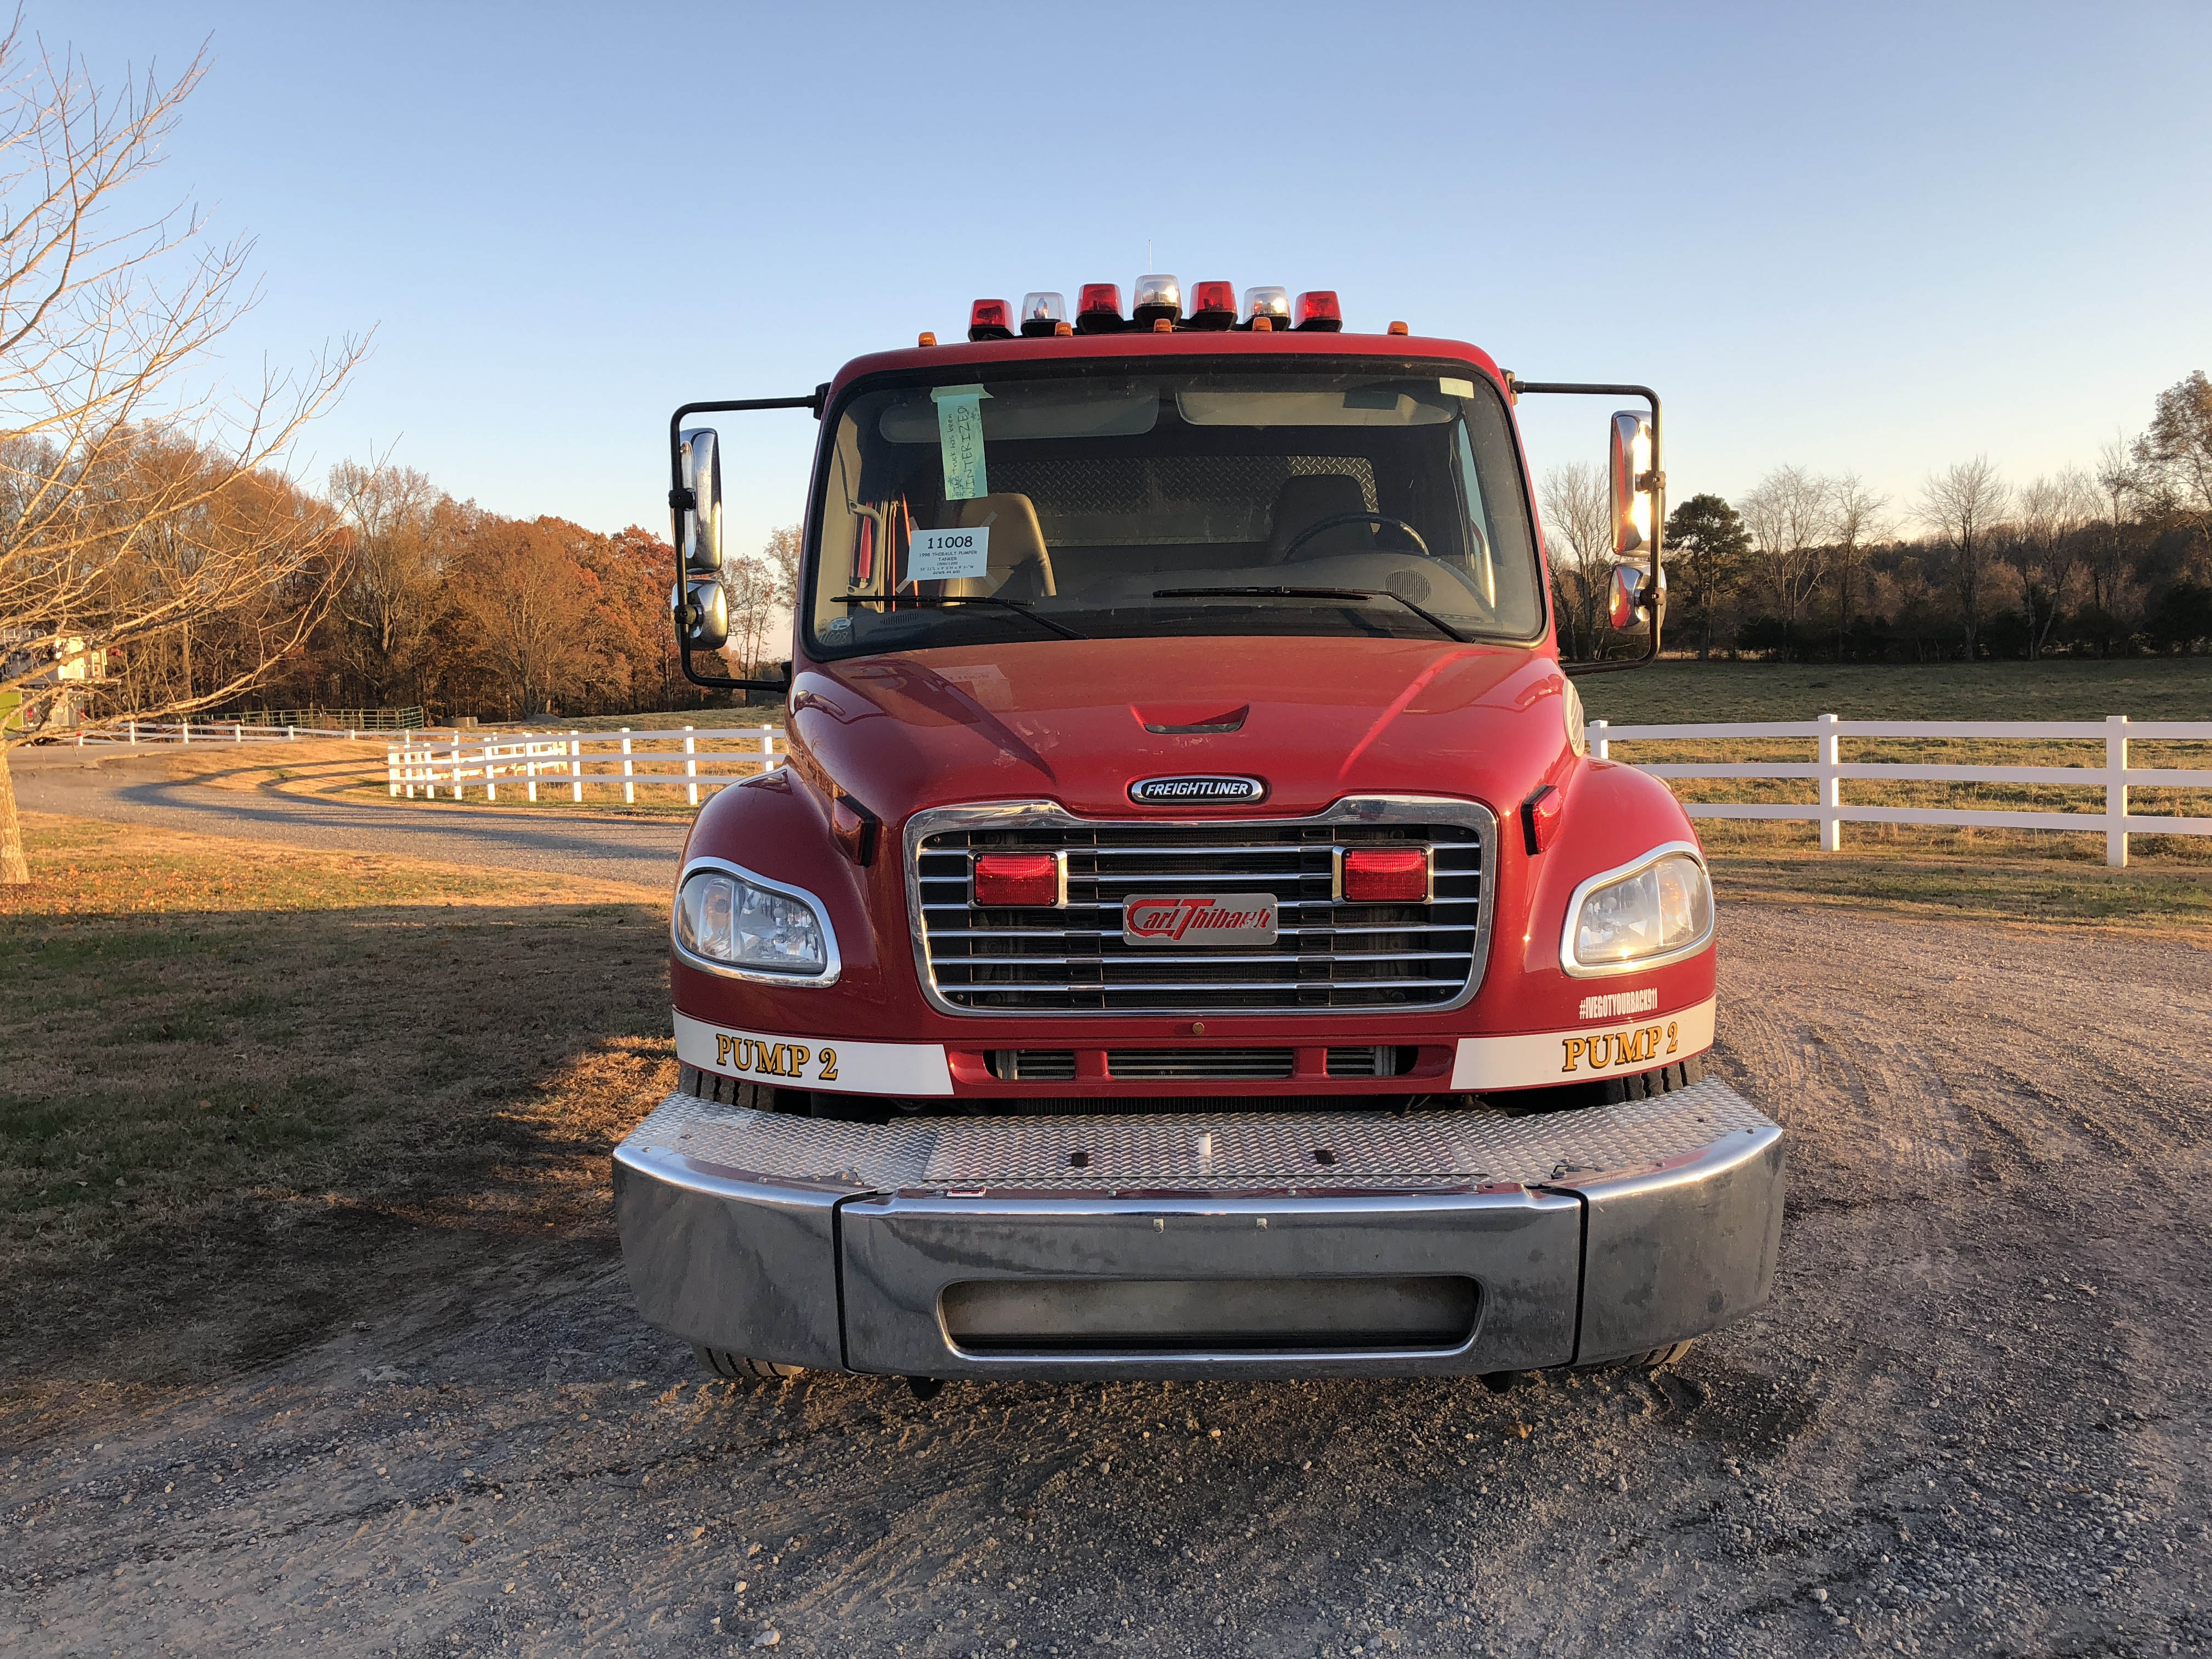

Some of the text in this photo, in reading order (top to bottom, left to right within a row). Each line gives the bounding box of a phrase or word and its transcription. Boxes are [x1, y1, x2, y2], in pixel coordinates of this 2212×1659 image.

[927, 535, 973, 549] 11008
[1146, 782, 1249, 795] FREIGHTLINER
[1126, 899, 1181, 937] Carl
[1579, 987, 1658, 1020] #IVEGOTYOURBACK911
[715, 1033, 839, 1081] PUMP 2
[1562, 1021, 1679, 1073] PUMP 2
